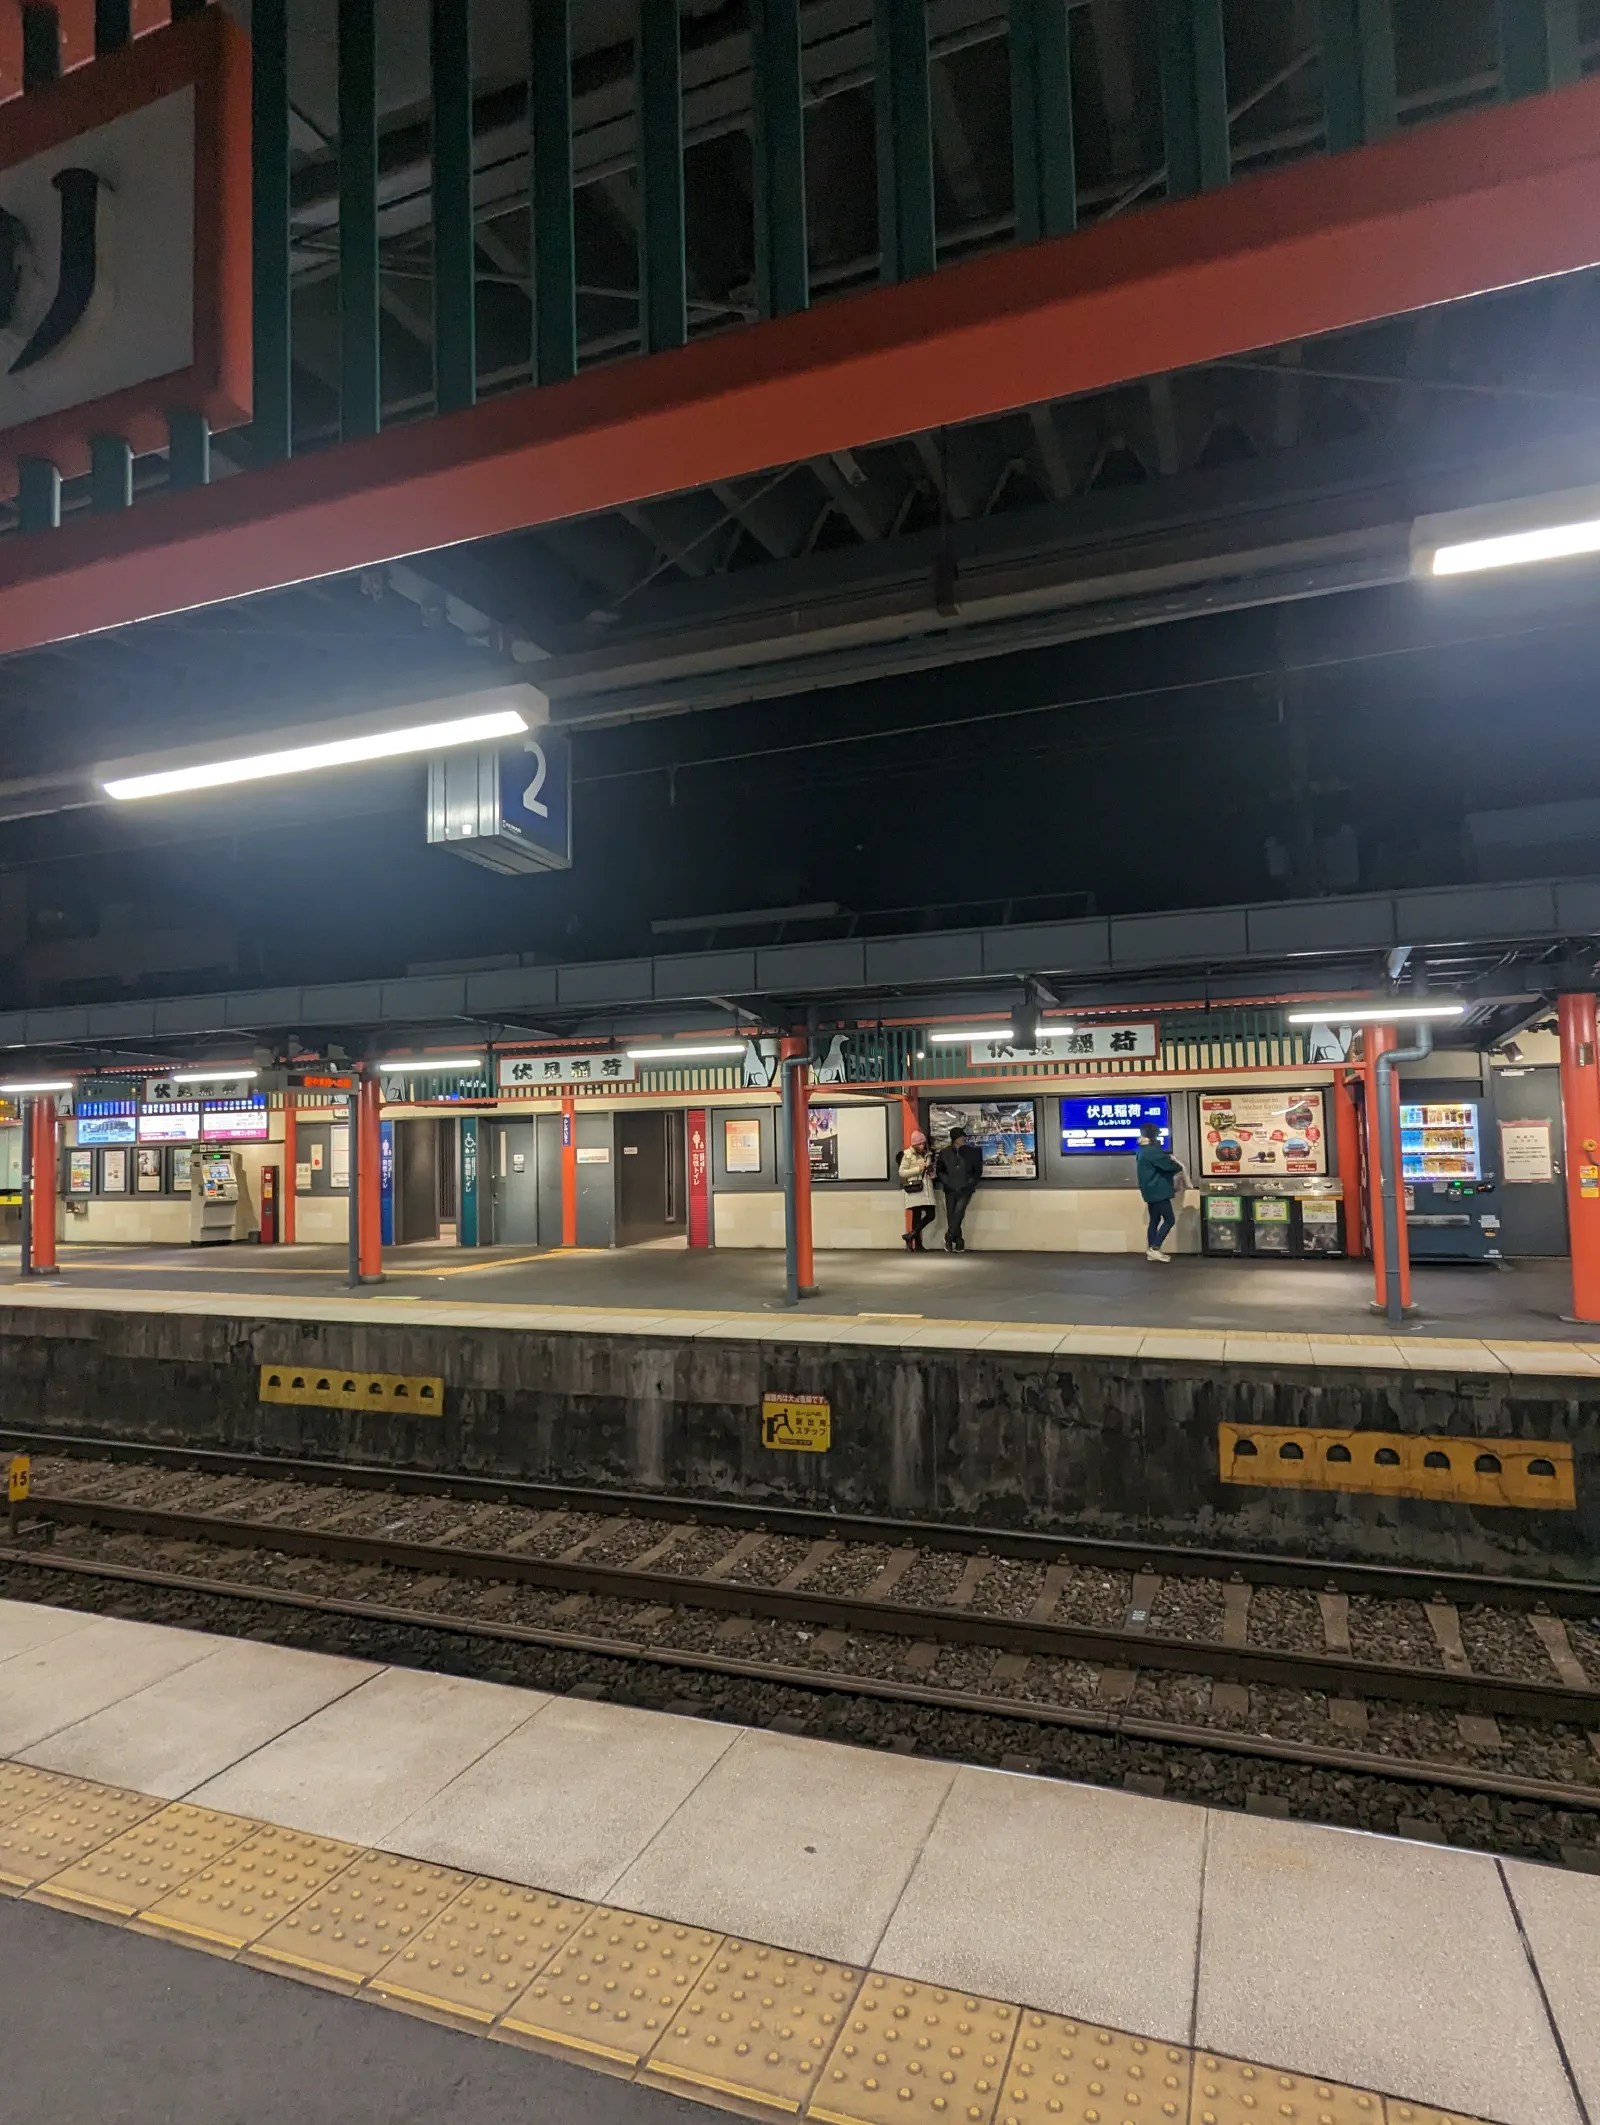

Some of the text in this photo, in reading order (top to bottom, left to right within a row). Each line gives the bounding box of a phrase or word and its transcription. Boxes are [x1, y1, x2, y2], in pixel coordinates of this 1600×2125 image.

[522, 740, 548, 818] 2
[511, 1058, 622, 1081] 伏見稲荷
[1086, 1103, 1142, 1118] 伏見稲荷
[692, 1152, 700, 1186] 女性トイレ
[796, 1427, 826, 1436] ステップ
[11, 1470, 28, 1488] 15
